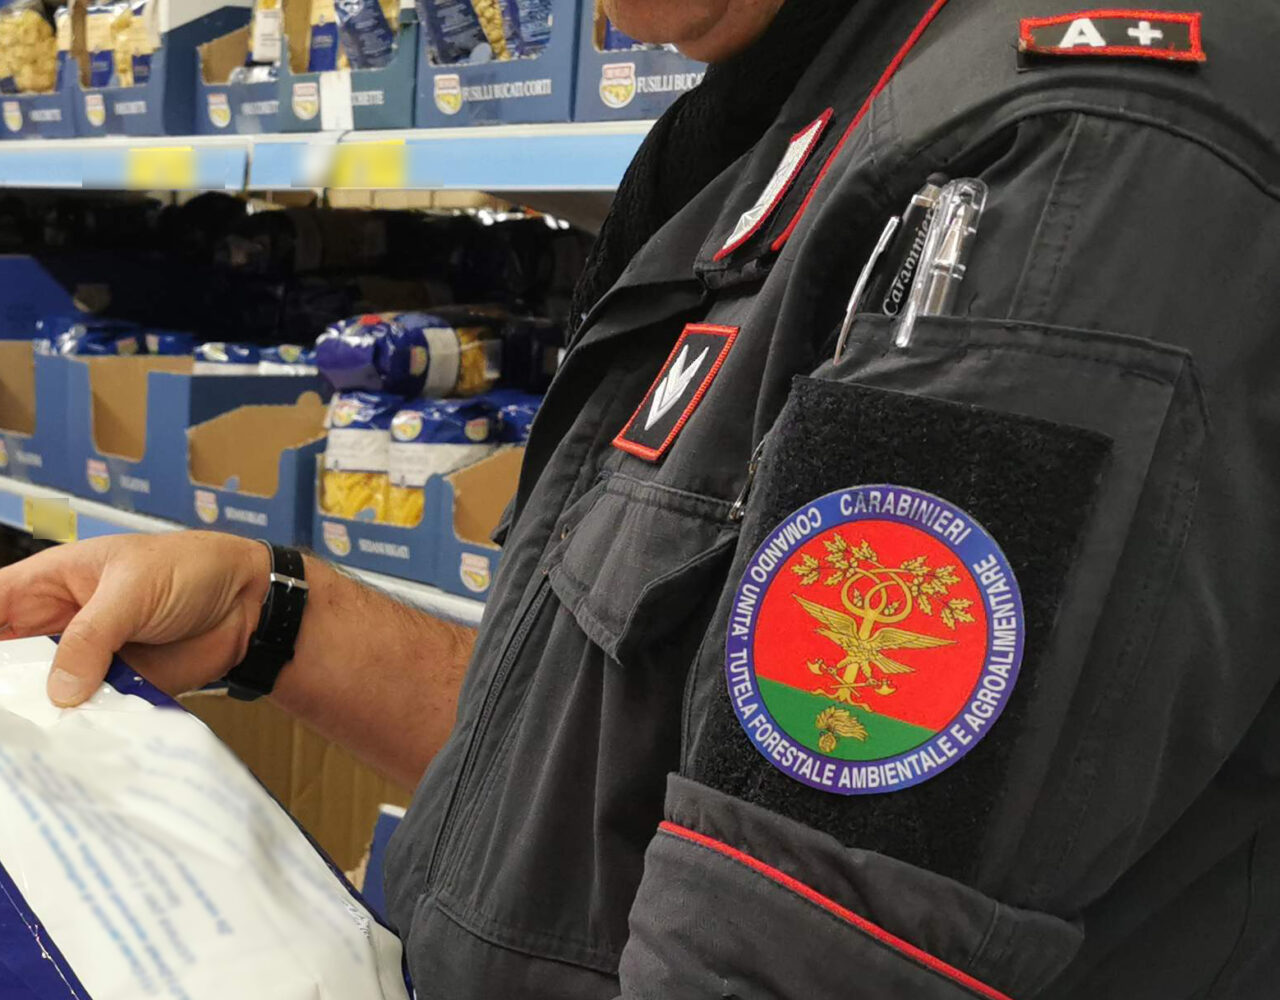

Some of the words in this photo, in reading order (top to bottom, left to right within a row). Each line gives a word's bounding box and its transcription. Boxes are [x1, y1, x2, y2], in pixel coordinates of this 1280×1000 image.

[1058, 17, 1107, 49] A
[750, 507, 822, 583] COMANDO
[840, 490, 972, 545] CARABINIERI
[969, 554, 1017, 733] AGROALIMENTARE
[729, 648, 759, 720] TUTELA
[748, 714, 836, 786] FORESTALE
[838, 735, 958, 789] AMBIENTALE
[950, 723, 973, 745] E
